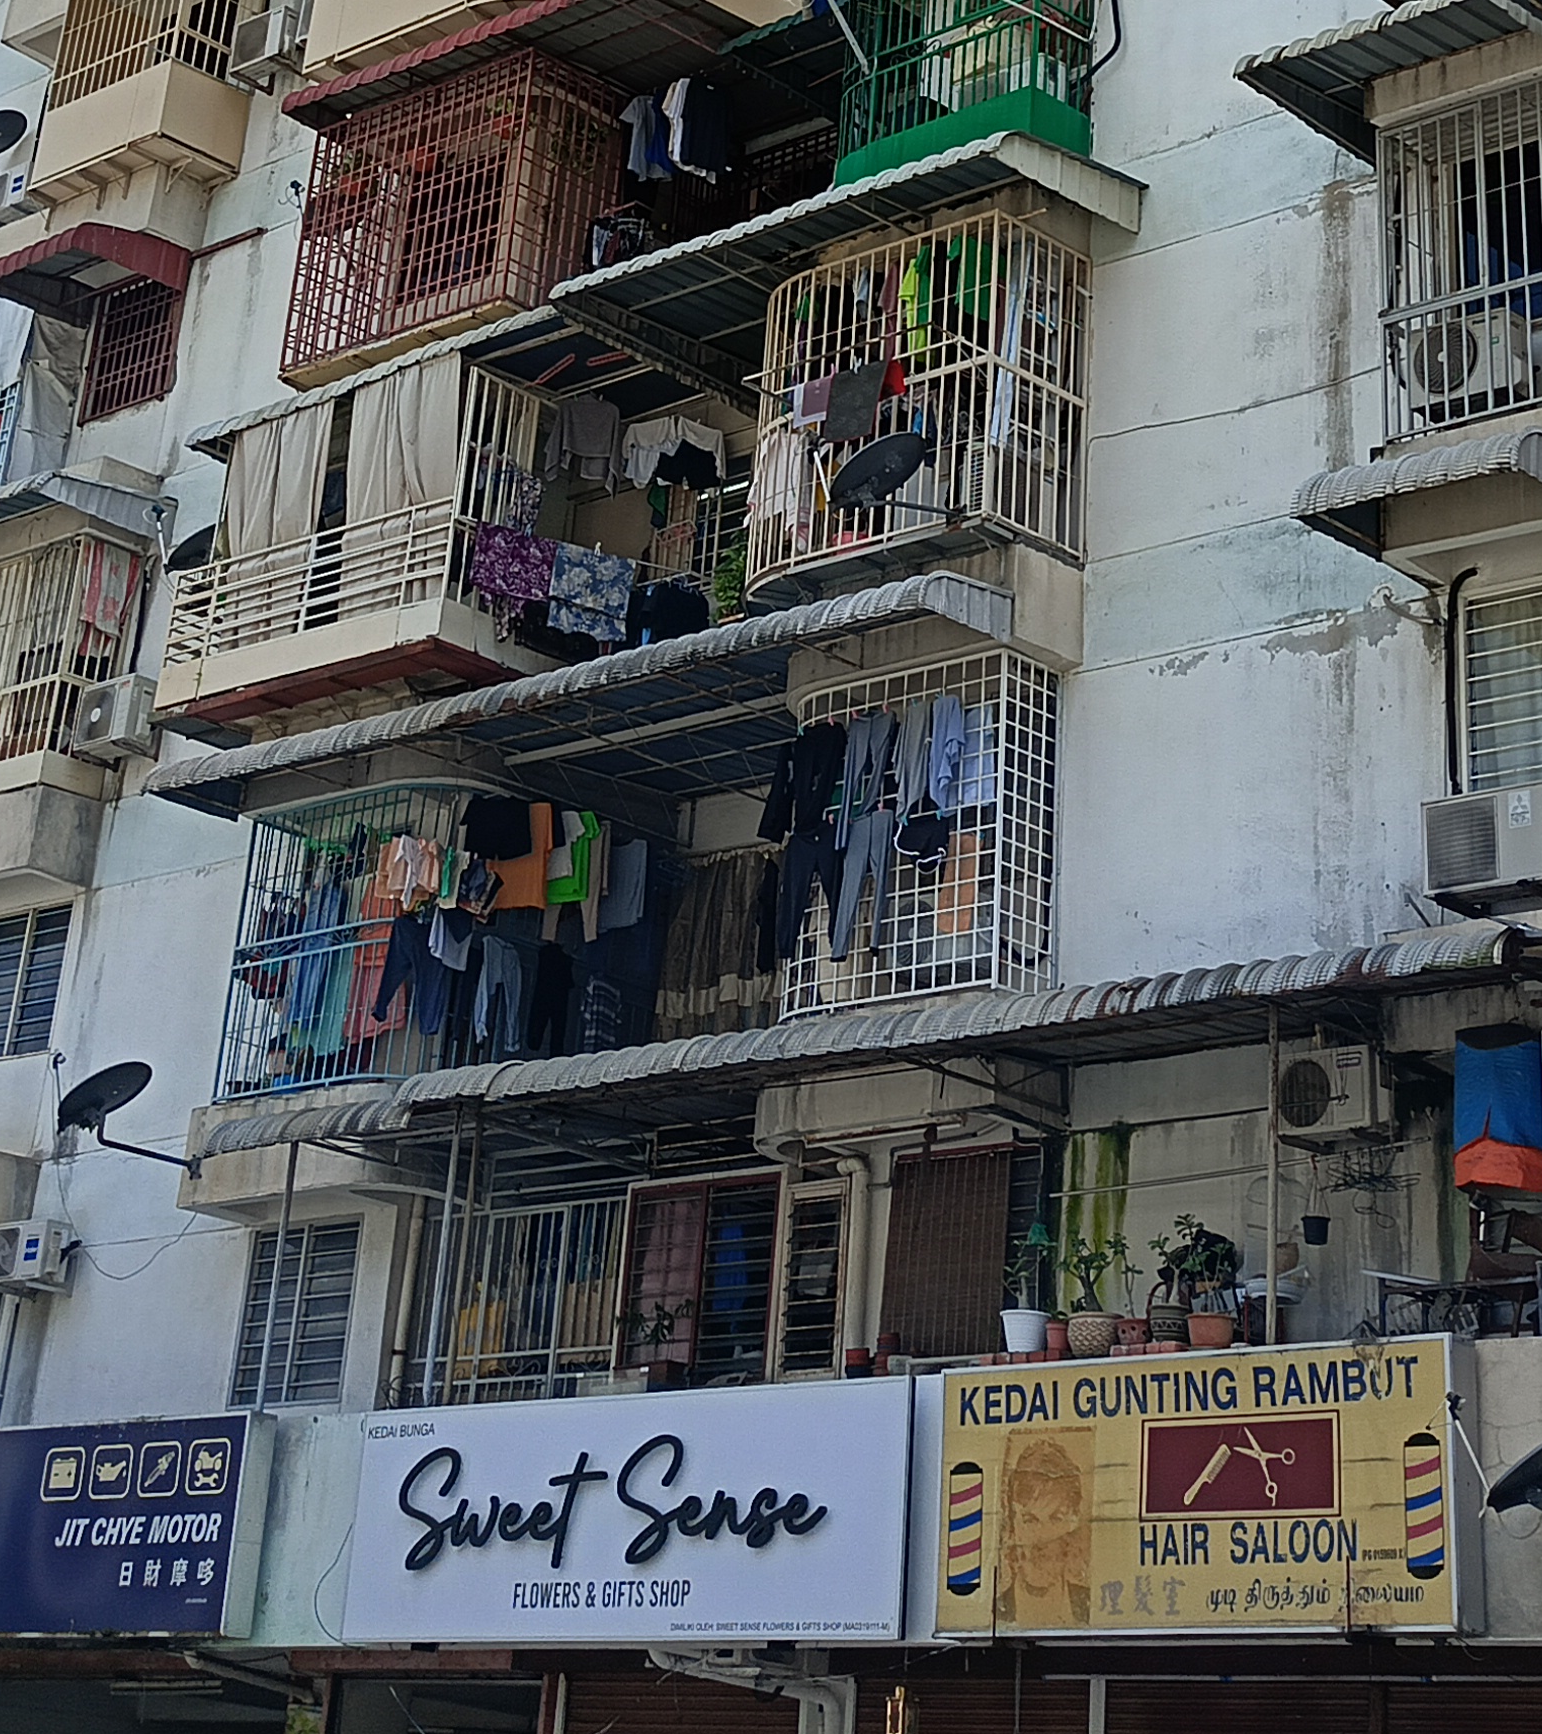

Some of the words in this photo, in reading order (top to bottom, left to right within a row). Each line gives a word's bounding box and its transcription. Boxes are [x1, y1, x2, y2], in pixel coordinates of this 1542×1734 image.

[959, 1380, 1059, 1426] KEDAI
[1073, 1367, 1238, 1418] GUNTING
[1253, 1356, 1419, 1408] RAMBUT
[367, 1424, 398, 1439] KEDAI
[399, 1422, 436, 1438] BUNGA
[398, 1446, 609, 1571] Sweet
[616, 1433, 828, 1565] Sense
[54, 1518, 91, 1547] JIT
[90, 1516, 147, 1546] CHYE
[146, 1513, 222, 1545] MOTOR
[1139, 1522, 1209, 1566] HAIR
[1230, 1518, 1358, 1565] SALOON
[512, 1581, 581, 1610] FLOWERS
[585, 1580, 597, 1608] &
[602, 1580, 646, 1607] GIFTS
[649, 1579, 691, 1607] SHOP
